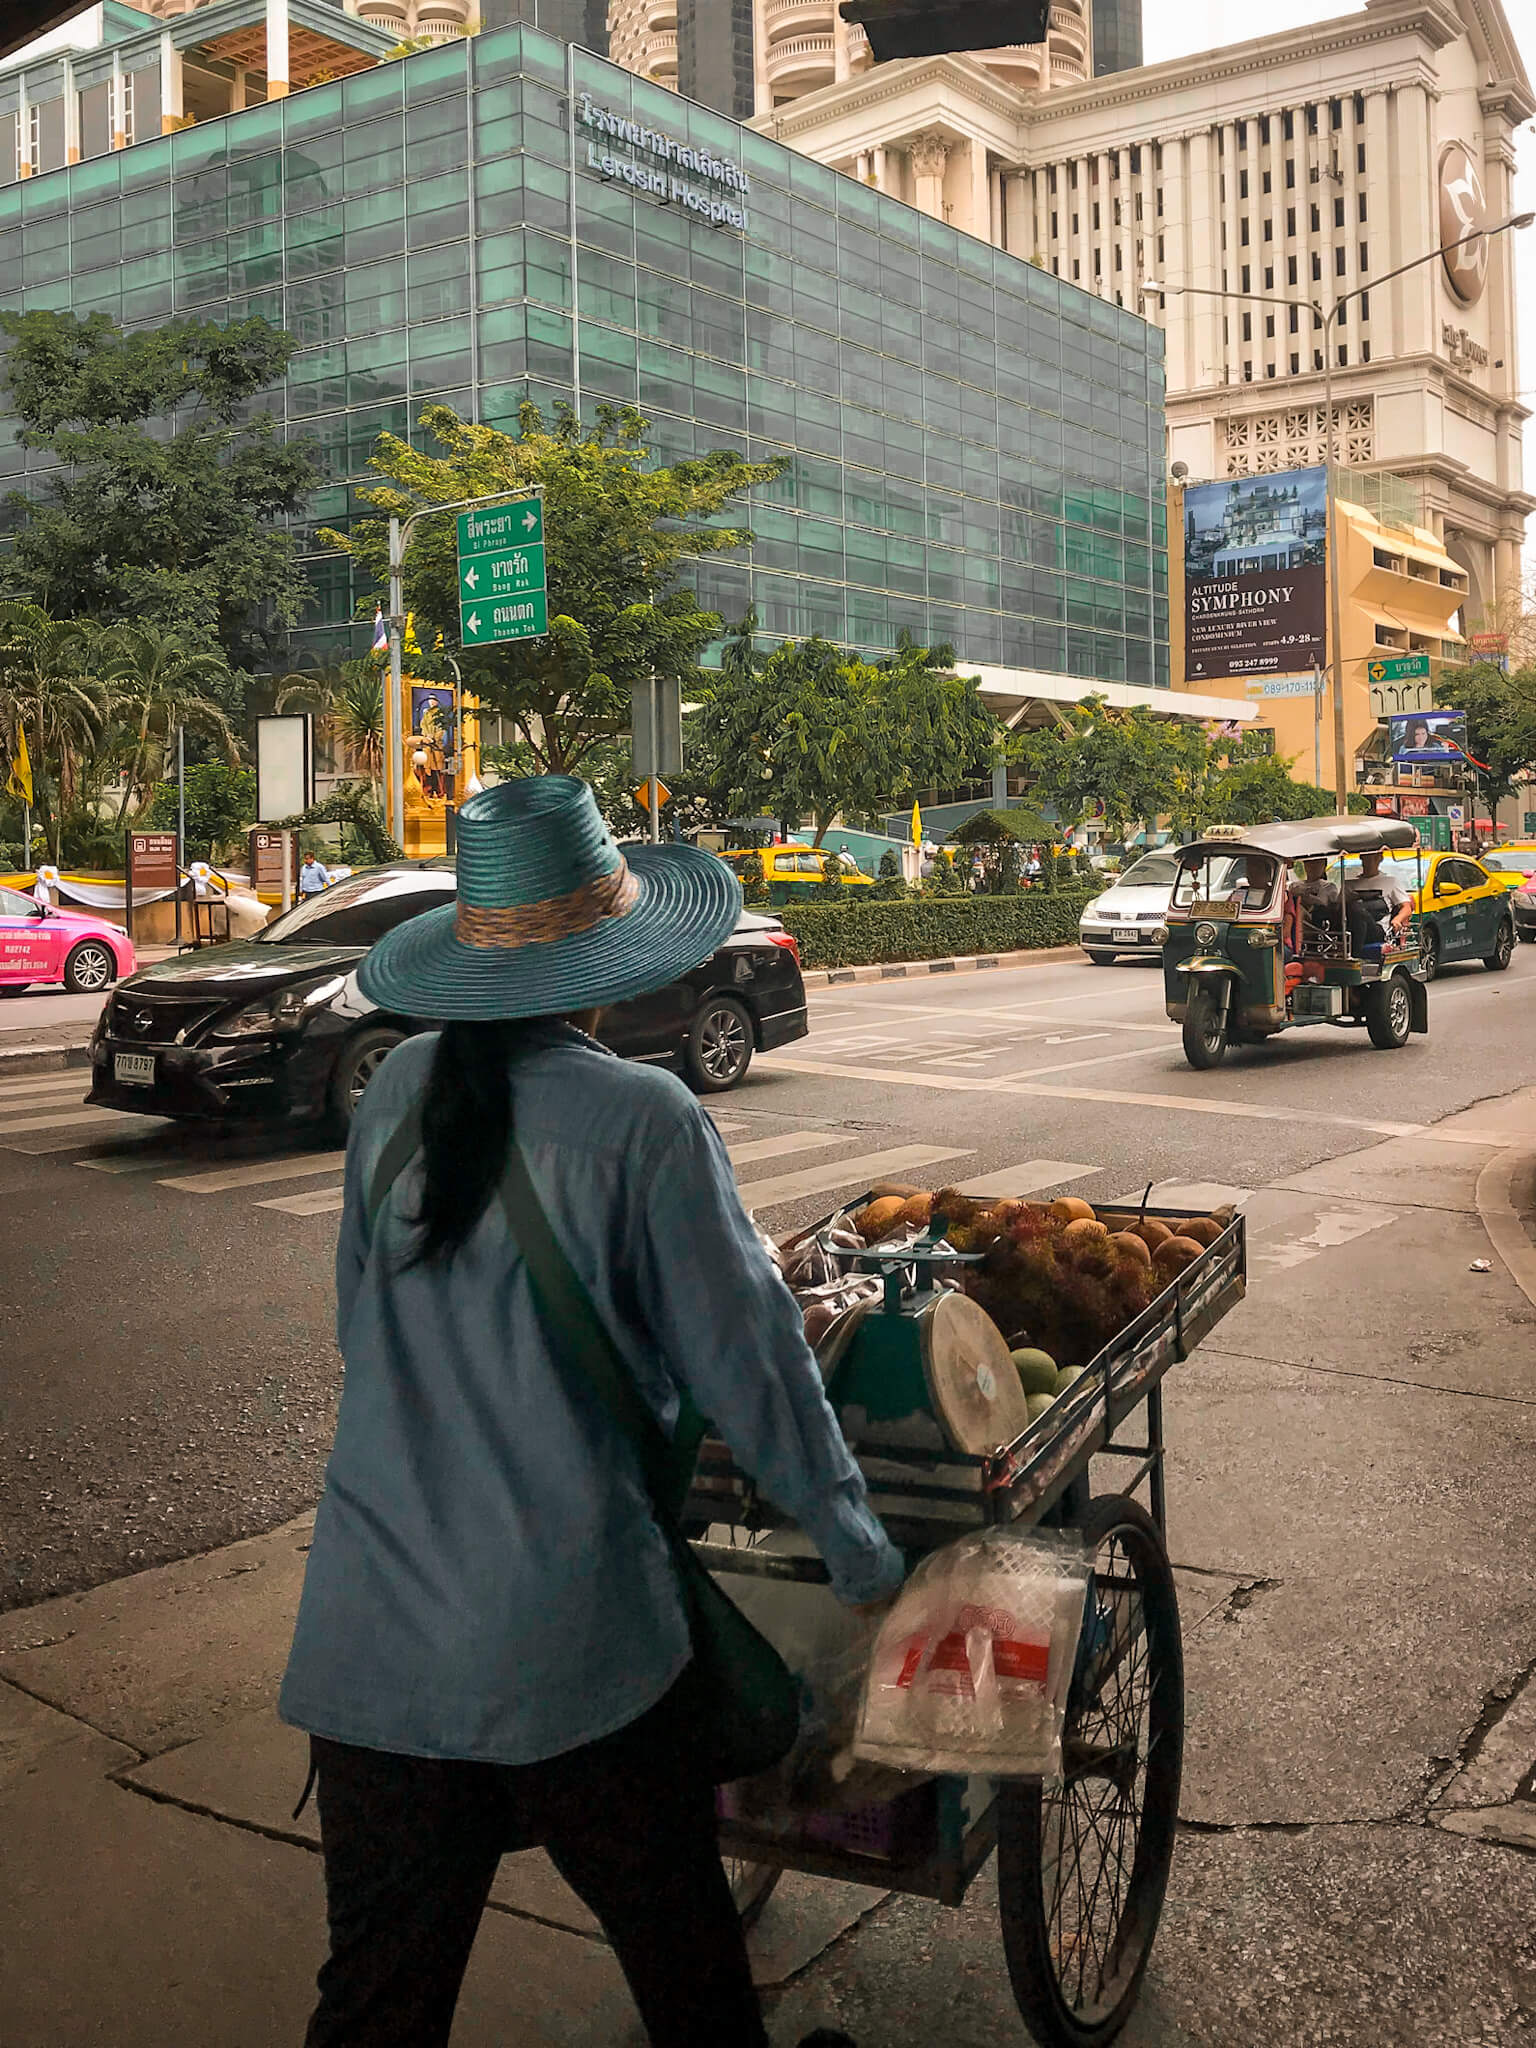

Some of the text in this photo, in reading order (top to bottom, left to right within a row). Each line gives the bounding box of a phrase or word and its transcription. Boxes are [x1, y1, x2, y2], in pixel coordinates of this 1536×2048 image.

[588, 142, 749, 231] Lerdsin Hospital
[491, 552, 529, 579] บางรัก
[1192, 582, 1239, 596] ALTITUDE
[1191, 587, 1295, 613] SYMPHONY
[493, 602, 534, 624] ถนนตก
[523, 624, 536, 633] Tok
[1208, 622, 1235, 632] LUXURY
[1236, 620, 1257, 629] RIVER
[1258, 618, 1277, 627] VIEW
[1191, 630, 1243, 642] CONDOMINIUM
[1280, 633, 1311, 645] 4.9-28
[1211, 826, 1234, 835] TAXI
